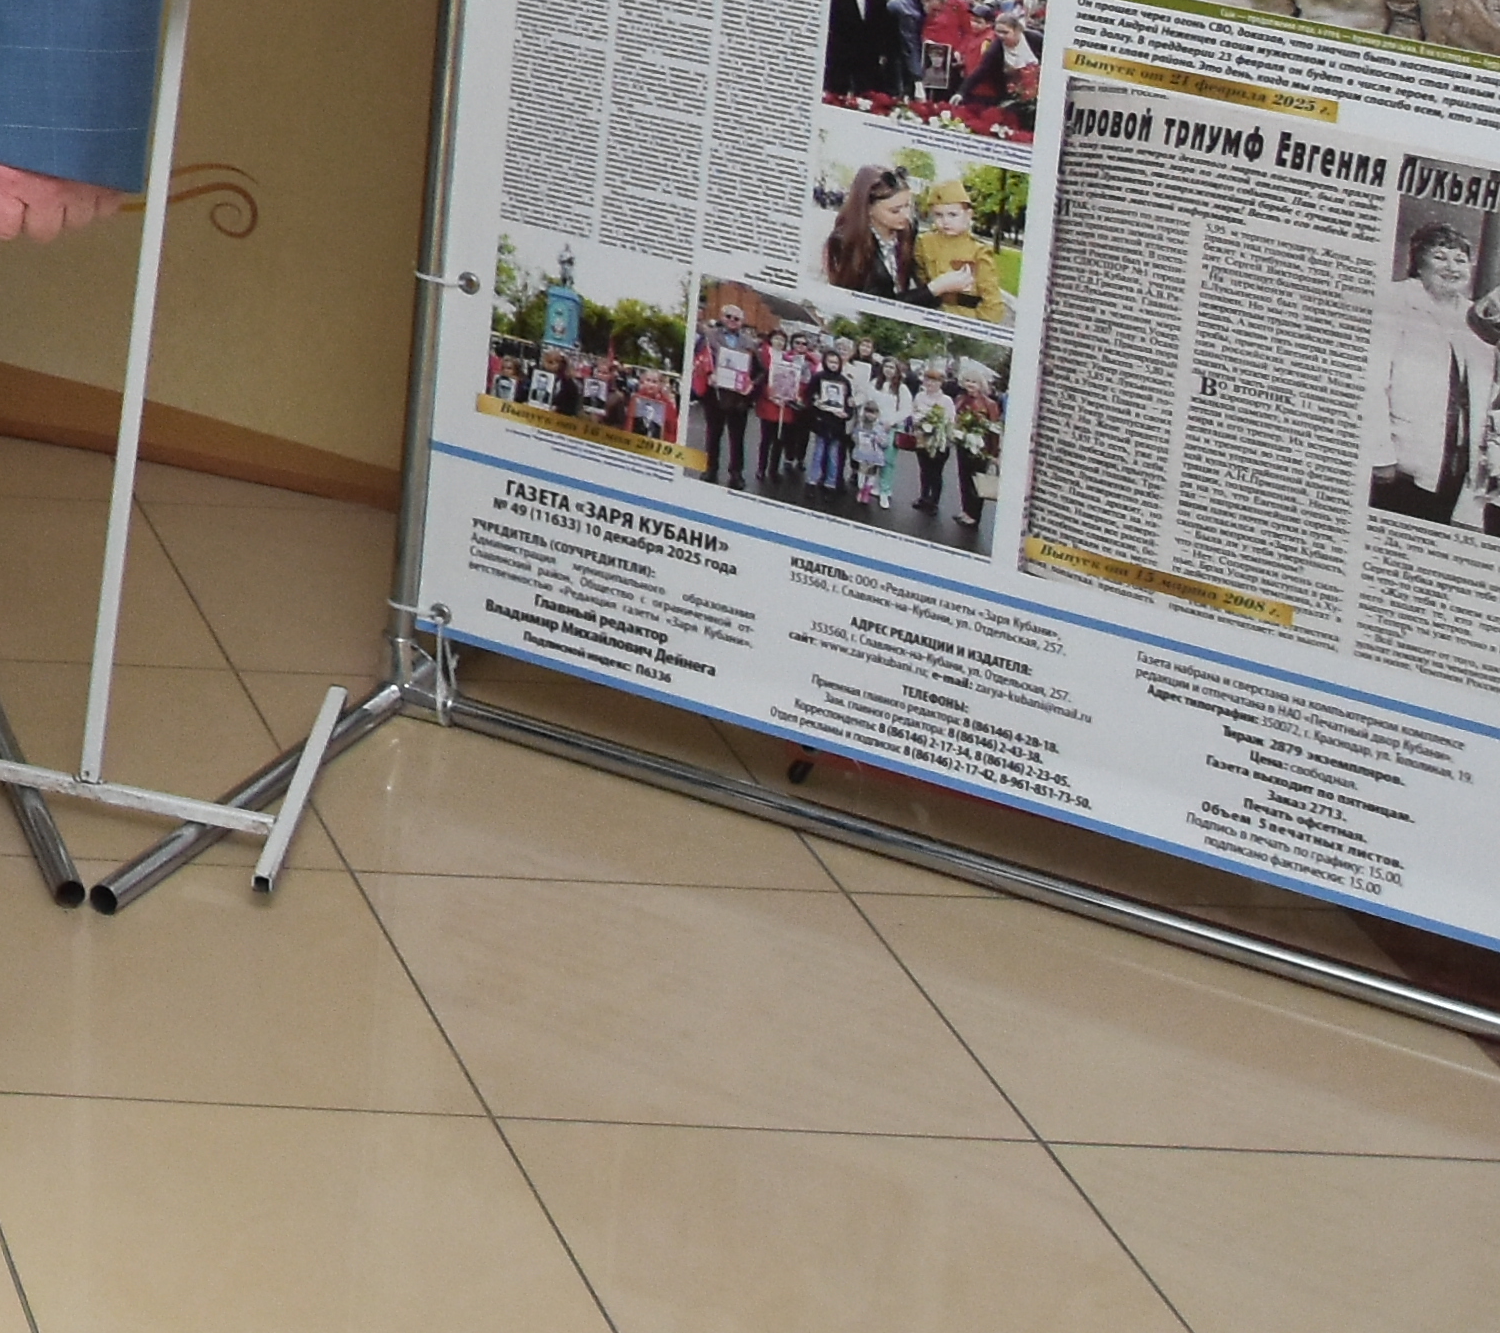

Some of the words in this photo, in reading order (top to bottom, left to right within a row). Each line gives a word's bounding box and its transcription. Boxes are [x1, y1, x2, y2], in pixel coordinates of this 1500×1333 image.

[1271, 93, 1316, 111] 2025
[1163, 119, 1265, 163] триумф
[1274, 131, 1388, 188] Евгения
[493, 497, 508, 510] №
[510, 502, 527, 516] 49
[529, 507, 581, 533] (11633)
[585, 522, 601, 537] 10
[602, 530, 664, 555] декабря
[666, 544, 701, 565] 2025
[704, 558, 737, 575] года
[505, 479, 570, 512] ГАЗЕТА
[575, 501, 634, 529] «ЗАРЯ
[638, 515, 729, 551] КУБАНИ»
[485, 599, 559, 633] Владимир
[560, 620, 652, 658] Михайлович
[653, 647, 716, 677] Дейнега
[534, 594, 597, 623] Главный
[599, 615, 668, 644] редактор
